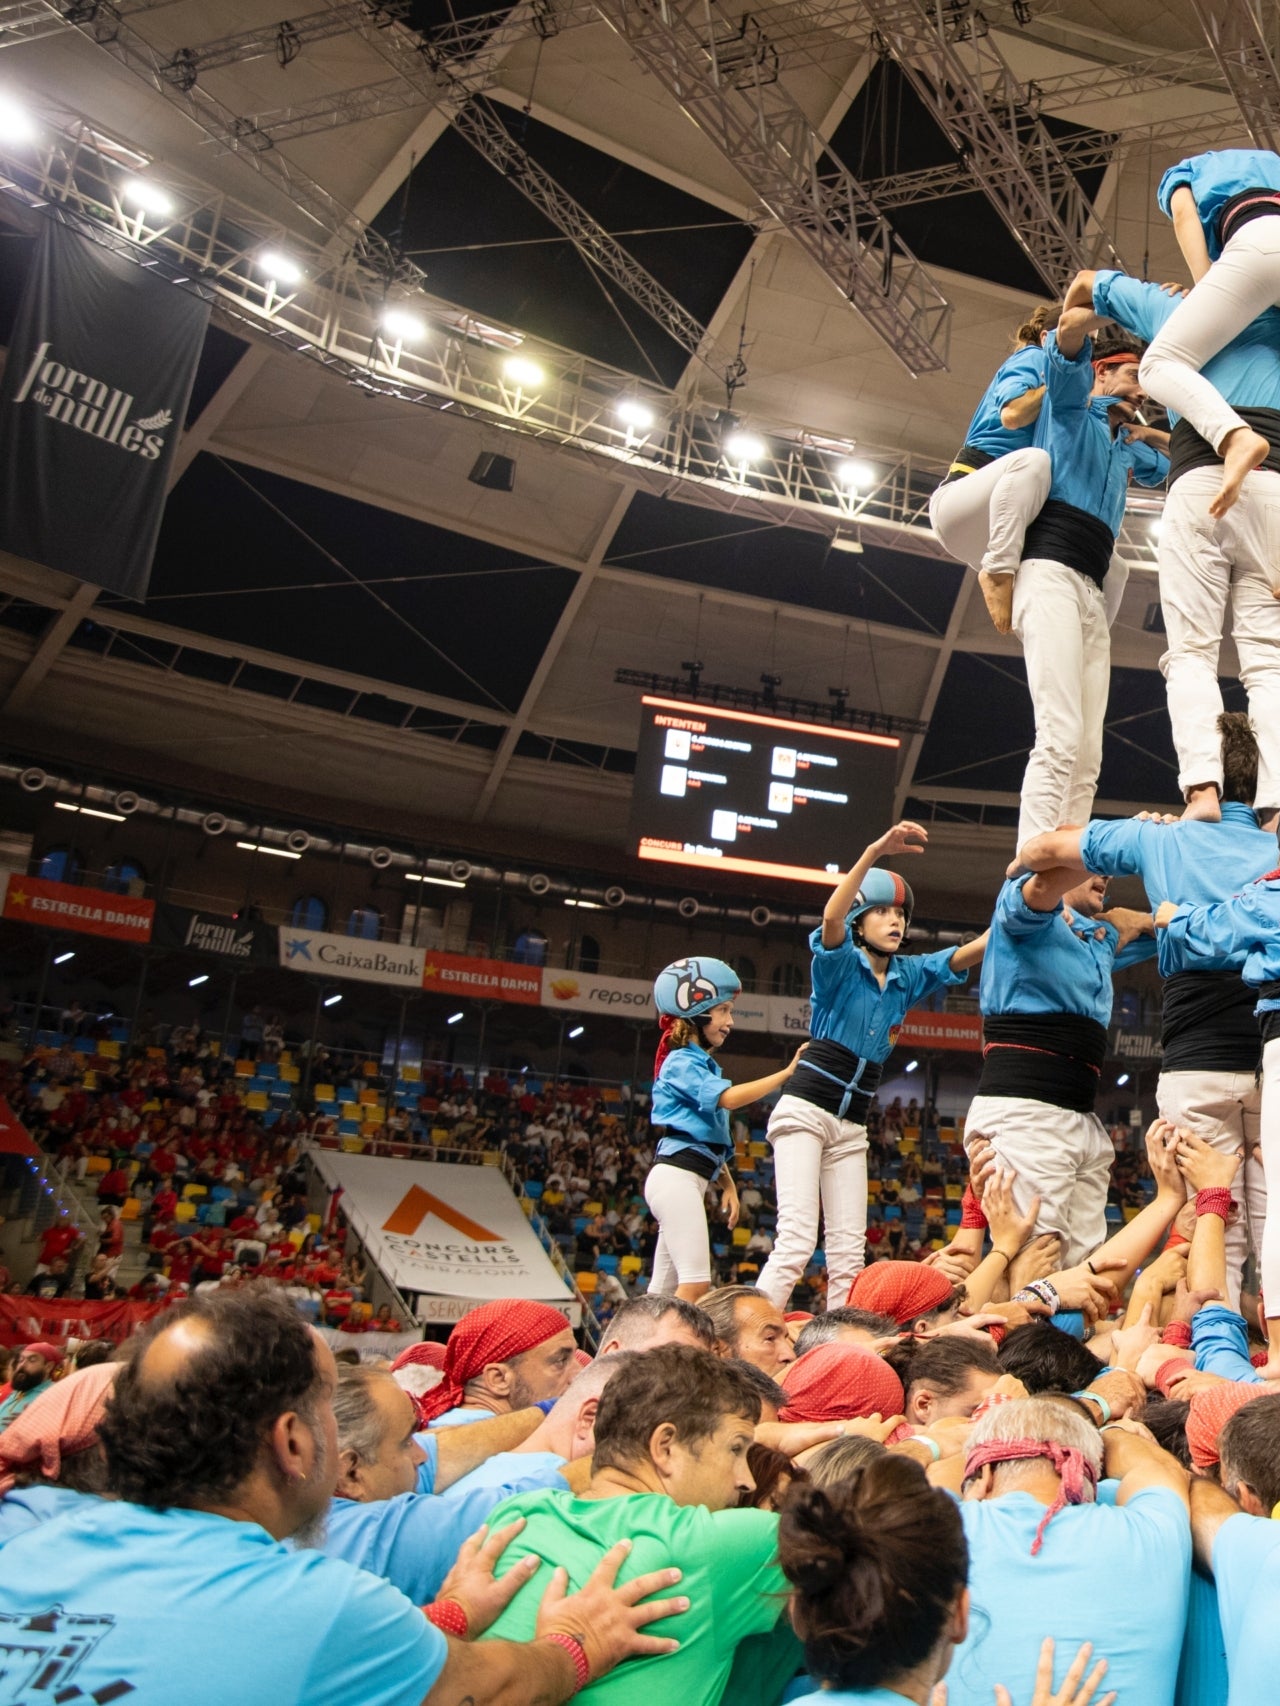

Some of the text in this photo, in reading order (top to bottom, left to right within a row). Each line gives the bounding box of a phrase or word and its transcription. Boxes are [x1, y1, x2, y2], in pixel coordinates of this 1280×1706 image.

[32, 387, 53, 406] de
[46, 387, 165, 460] nulles
[654, 714, 707, 732] INTENTEN
[640, 837, 683, 852] CONCURS
[31, 896, 150, 929] ESTRELLA DAMM
[318, 944, 420, 977] CaixaBank
[440, 968, 539, 993] ESTRELLA DAMM
[588, 987, 652, 1007] repsol
[945, 1027, 980, 1040] DAMM
[384, 1235, 515, 1254] CONCURS
[389, 1243, 521, 1263] CASTELLS
[399, 1258, 531, 1276] TARRAGONA
